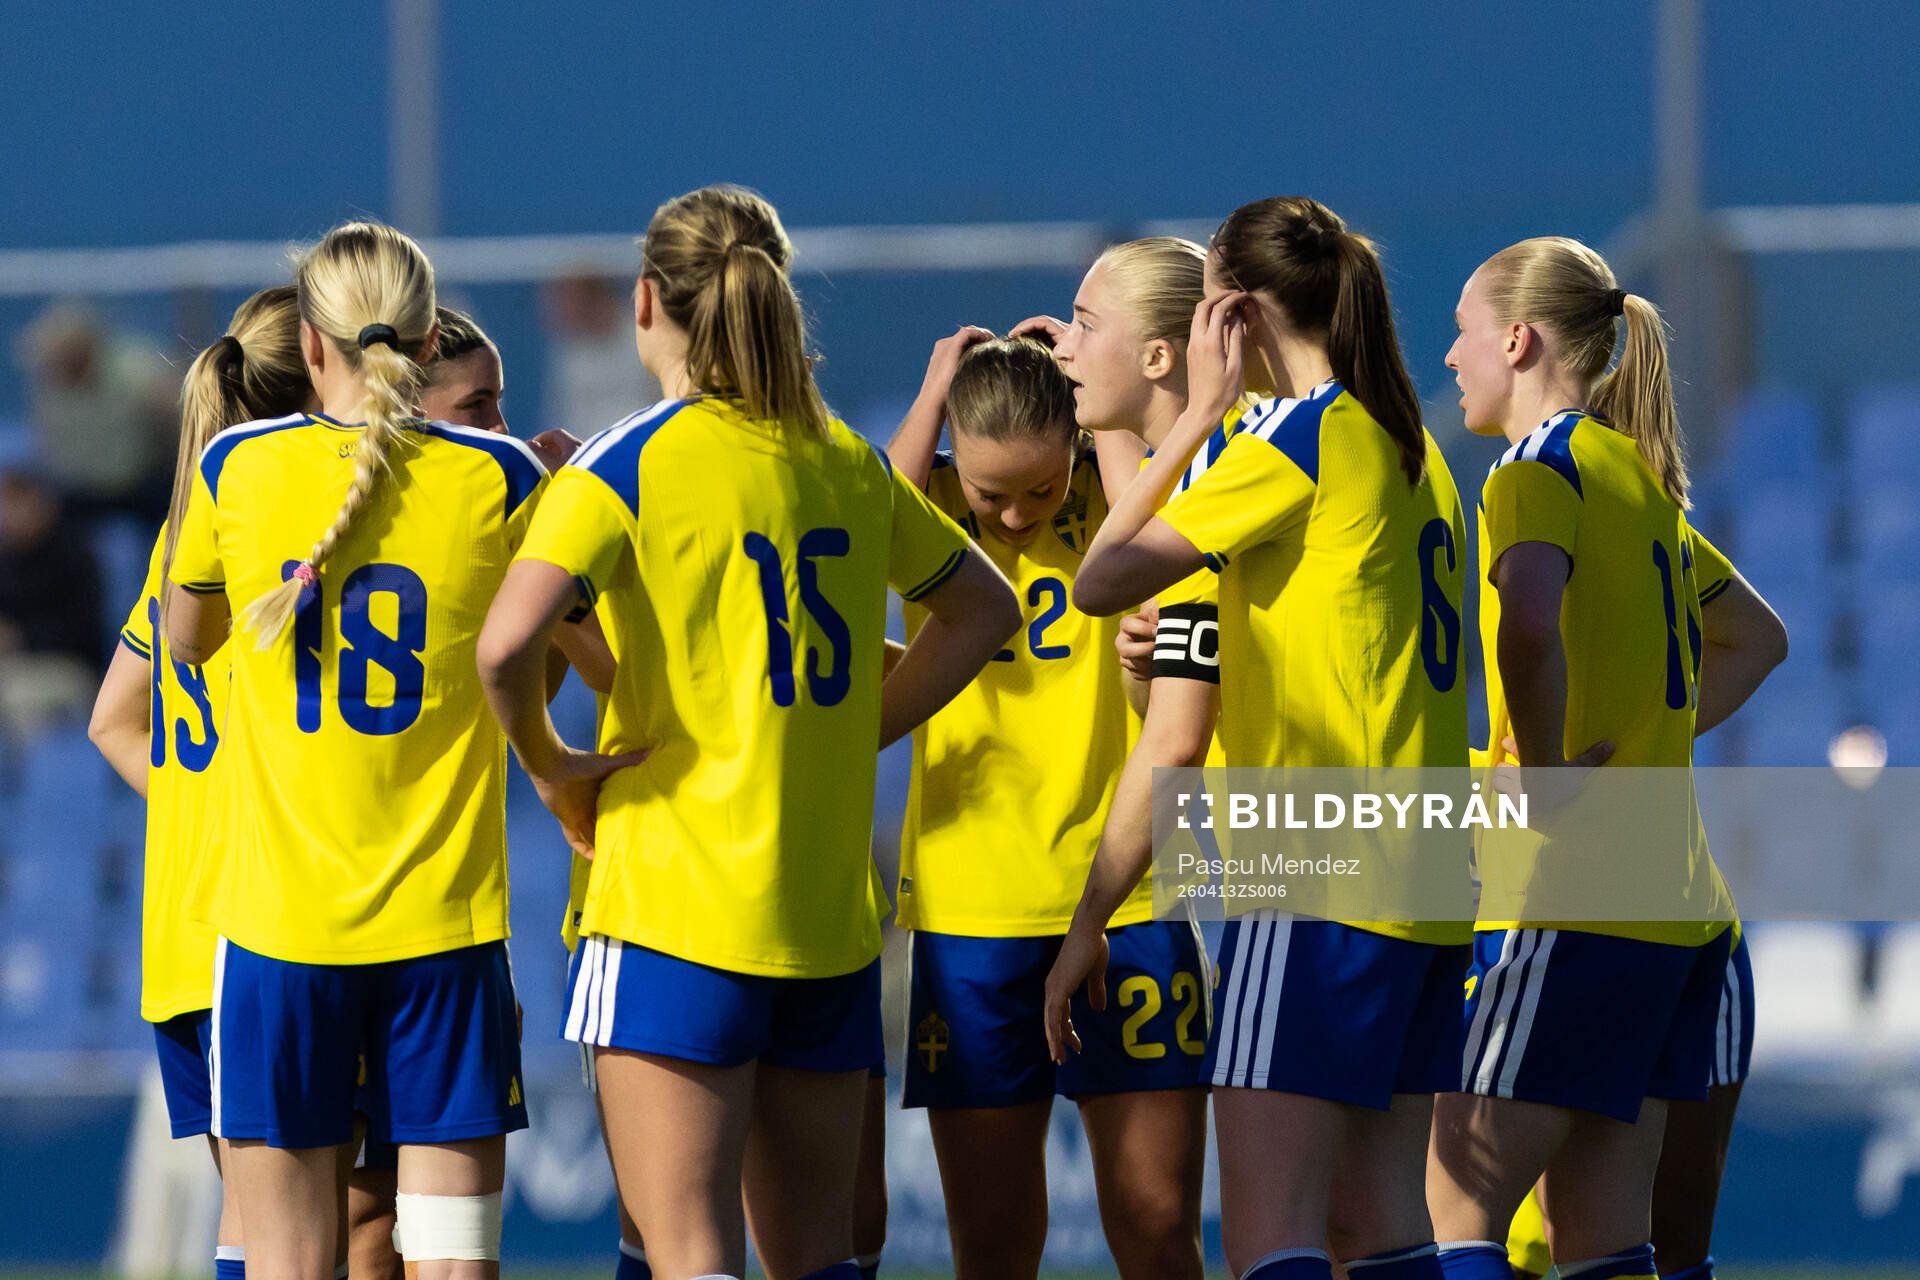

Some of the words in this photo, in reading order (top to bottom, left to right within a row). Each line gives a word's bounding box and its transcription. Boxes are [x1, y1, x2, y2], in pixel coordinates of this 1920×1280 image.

[281, 560, 427, 736] 18
[744, 527, 852, 707] 15
[991, 577, 1071, 662] 2
[1118, 971, 1205, 1059] 22
